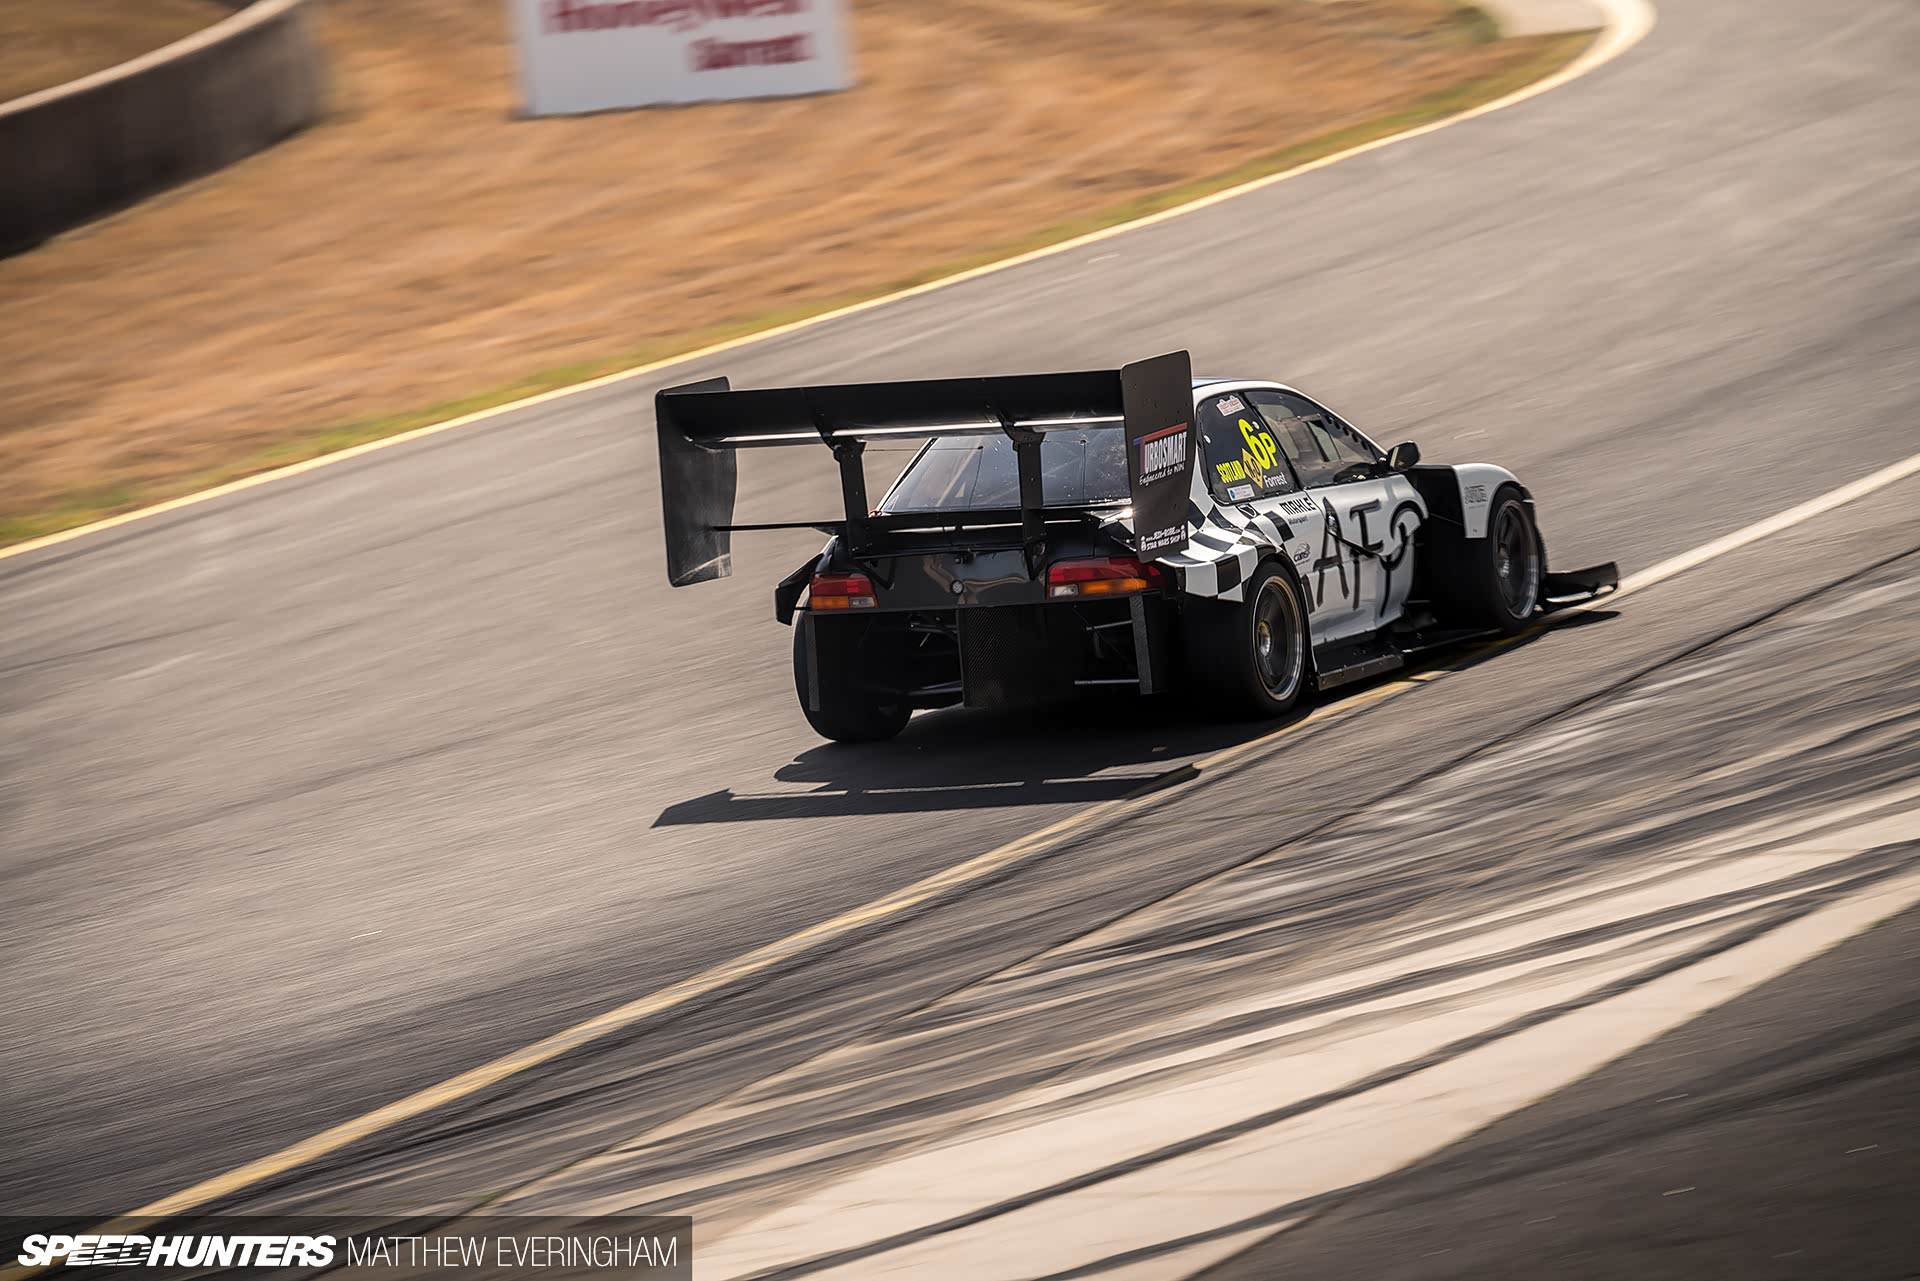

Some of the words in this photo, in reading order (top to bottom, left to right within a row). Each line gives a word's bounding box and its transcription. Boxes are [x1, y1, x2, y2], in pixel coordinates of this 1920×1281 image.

[1133, 422, 1188, 475] TURBOSMART
[1215, 460, 1247, 484] SCOTLAND
[1263, 471, 1288, 488] Forrest
[1278, 497, 1317, 515] MAHLE
[1157, 537, 1170, 548] WARS
